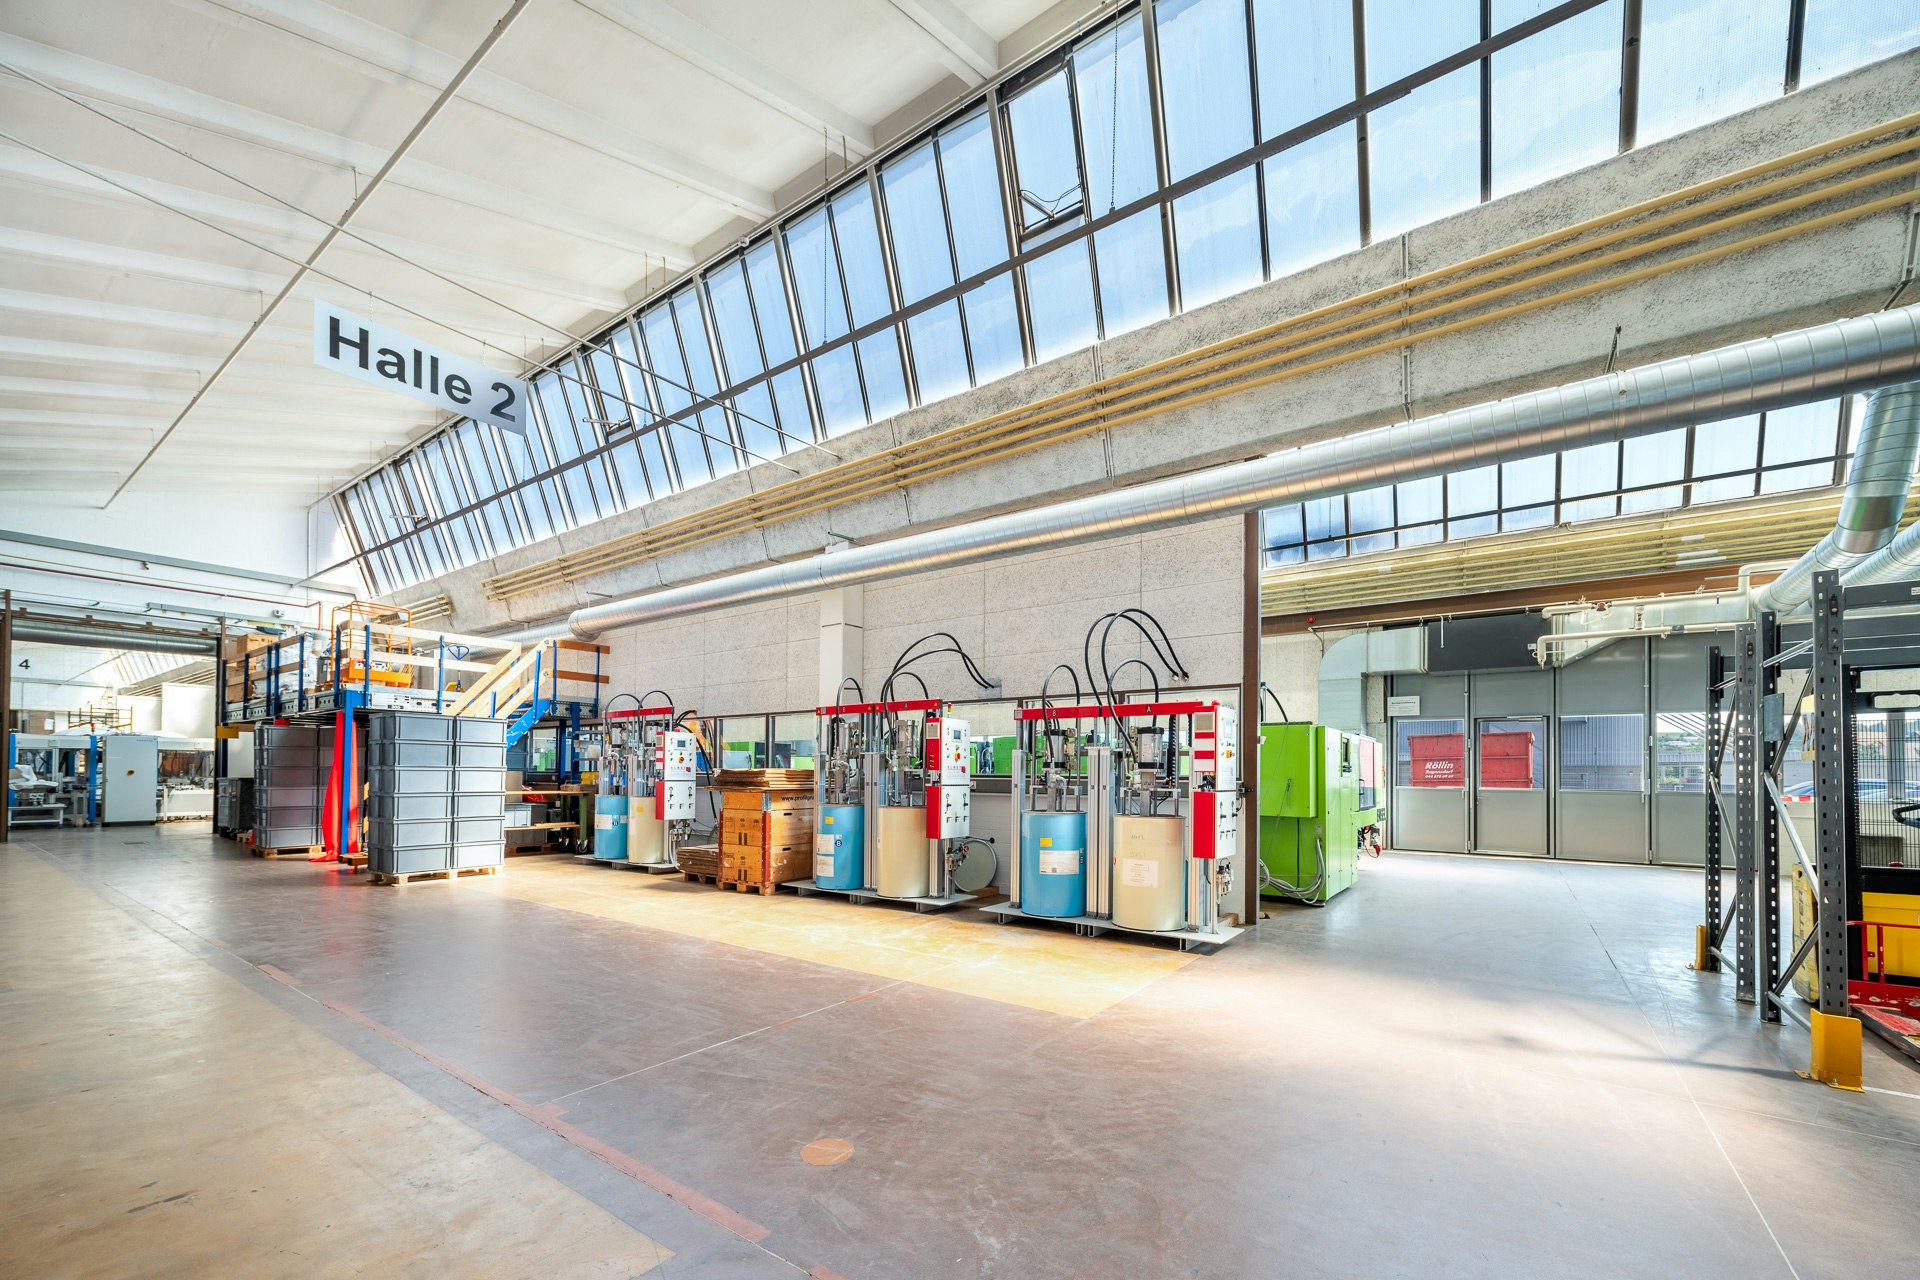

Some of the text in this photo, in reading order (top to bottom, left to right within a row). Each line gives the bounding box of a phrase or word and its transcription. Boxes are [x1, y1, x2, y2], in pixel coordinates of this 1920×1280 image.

[329, 315, 516, 422] Halle 2
[18, 659, 30, 669] 4
[1425, 761, 1454, 769] Röllin
